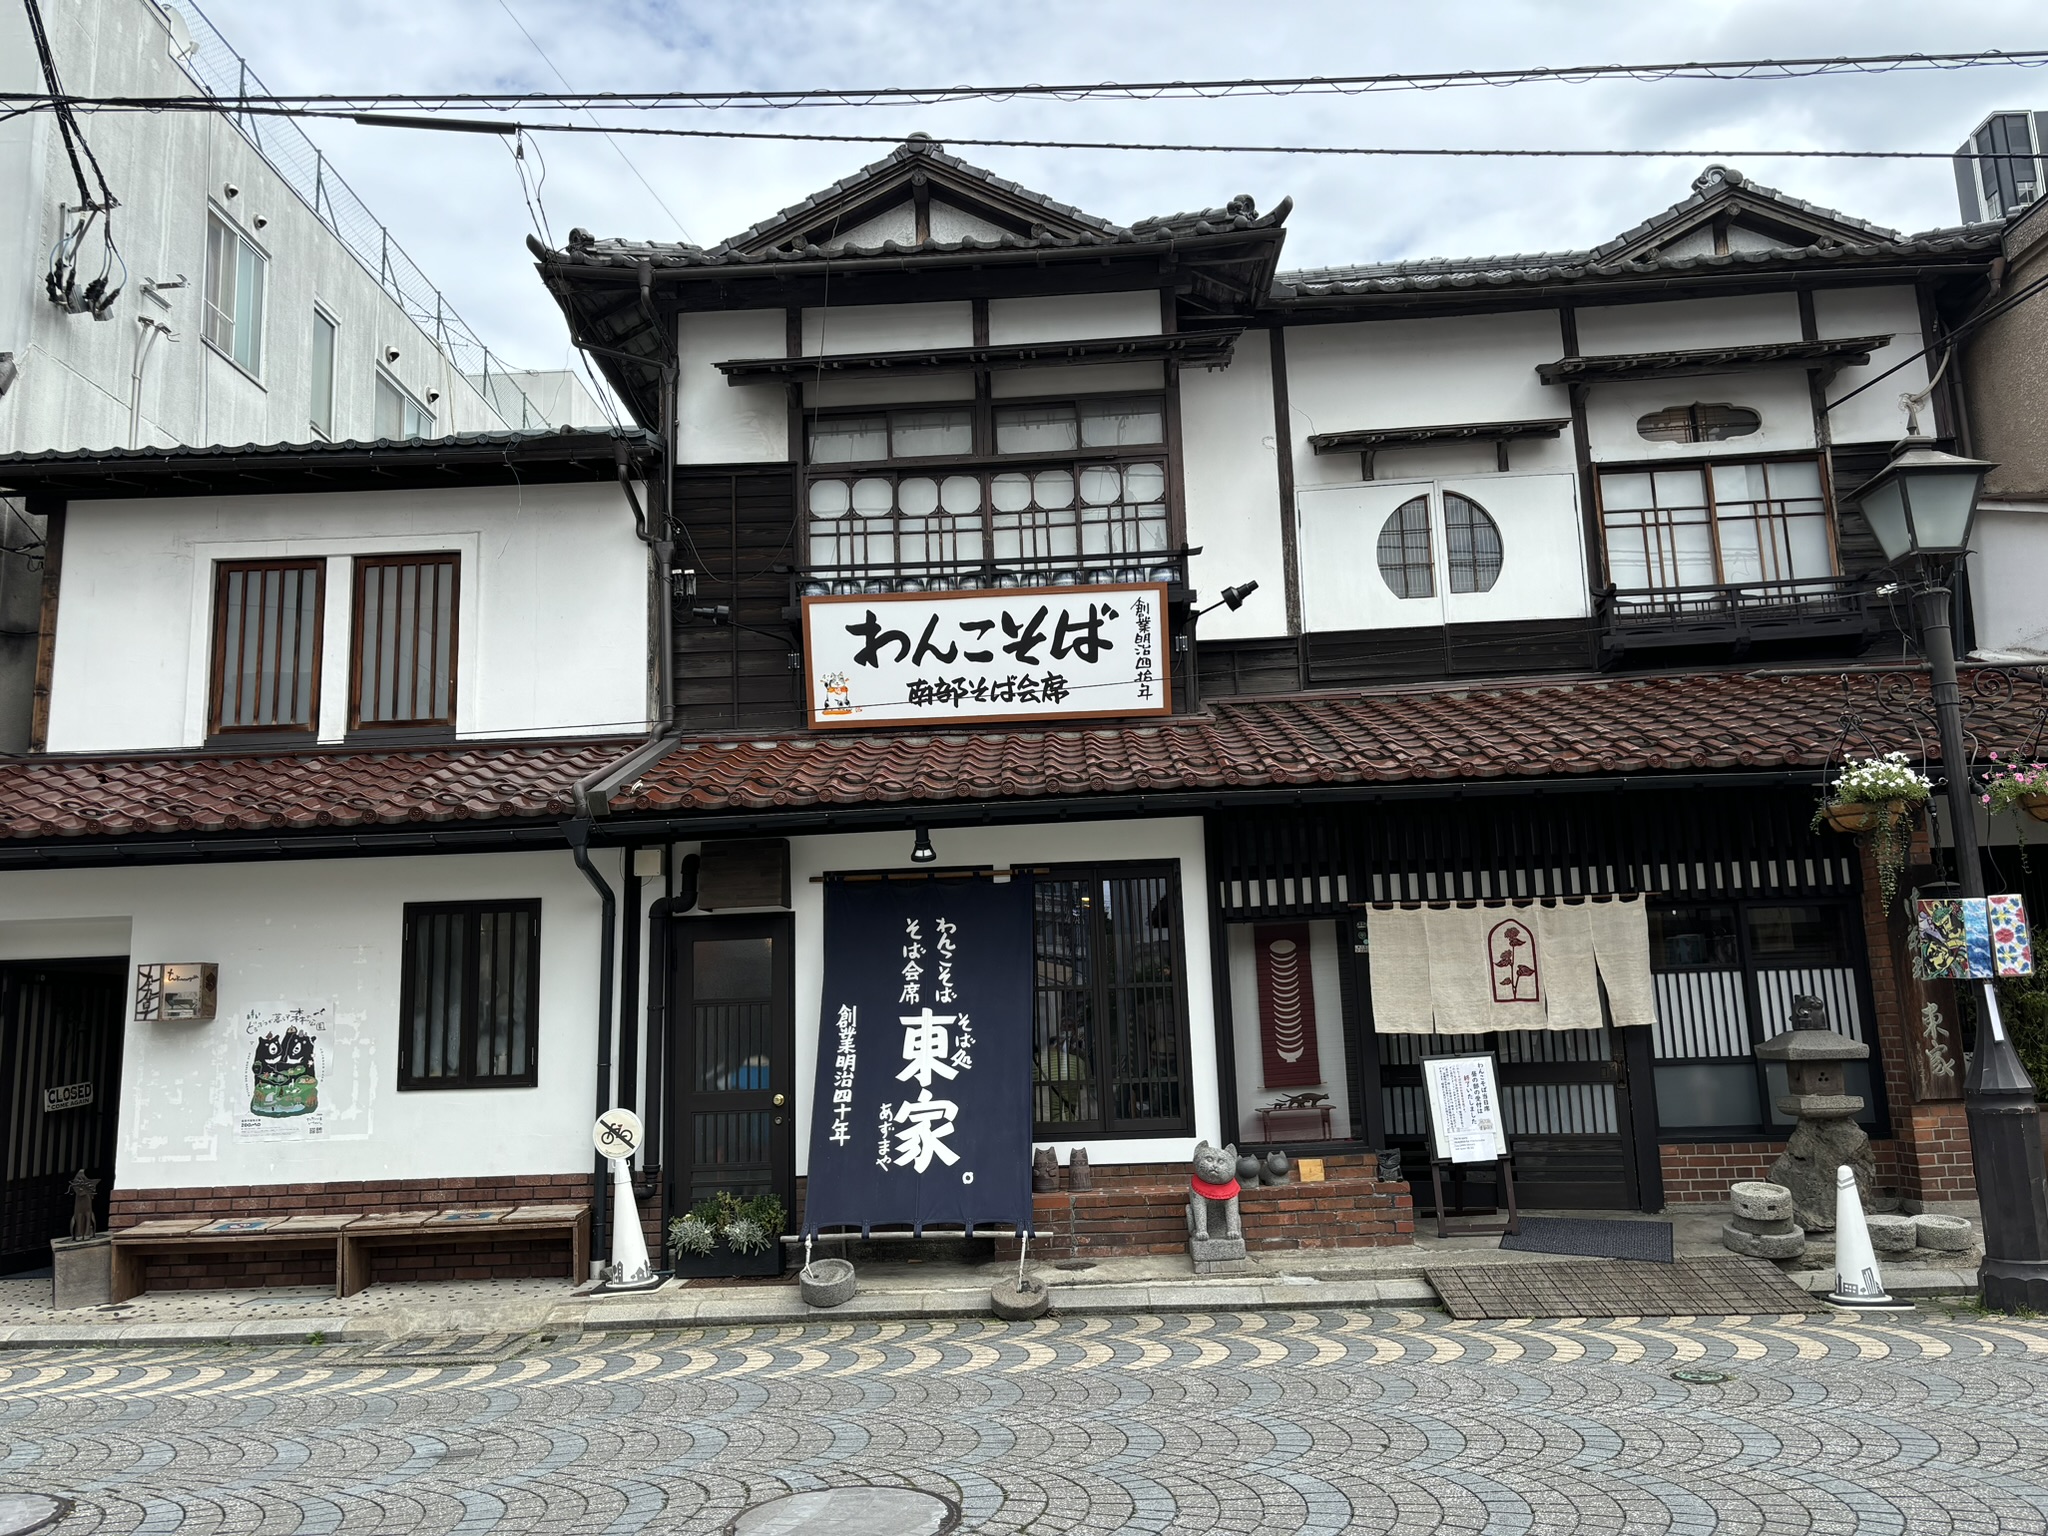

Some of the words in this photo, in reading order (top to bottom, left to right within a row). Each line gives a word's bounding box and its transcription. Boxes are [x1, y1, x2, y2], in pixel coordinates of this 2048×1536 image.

[845, 602, 1119, 668] わんこそば
[1130, 596, 1154, 701] 創業明治四拾年
[906, 671, 1071, 709] 南部そば会席
[898, 918, 927, 1005] そば会席
[935, 917, 958, 1004] わんこそば
[829, 1003, 857, 1147] 創業明治四十年
[950, 1012, 976, 1070] そば処
[1921, 1001, 1956, 1077] 東家
[48, 1083, 92, 1104] CLOSED
[875, 1102, 895, 1172] あずまや
